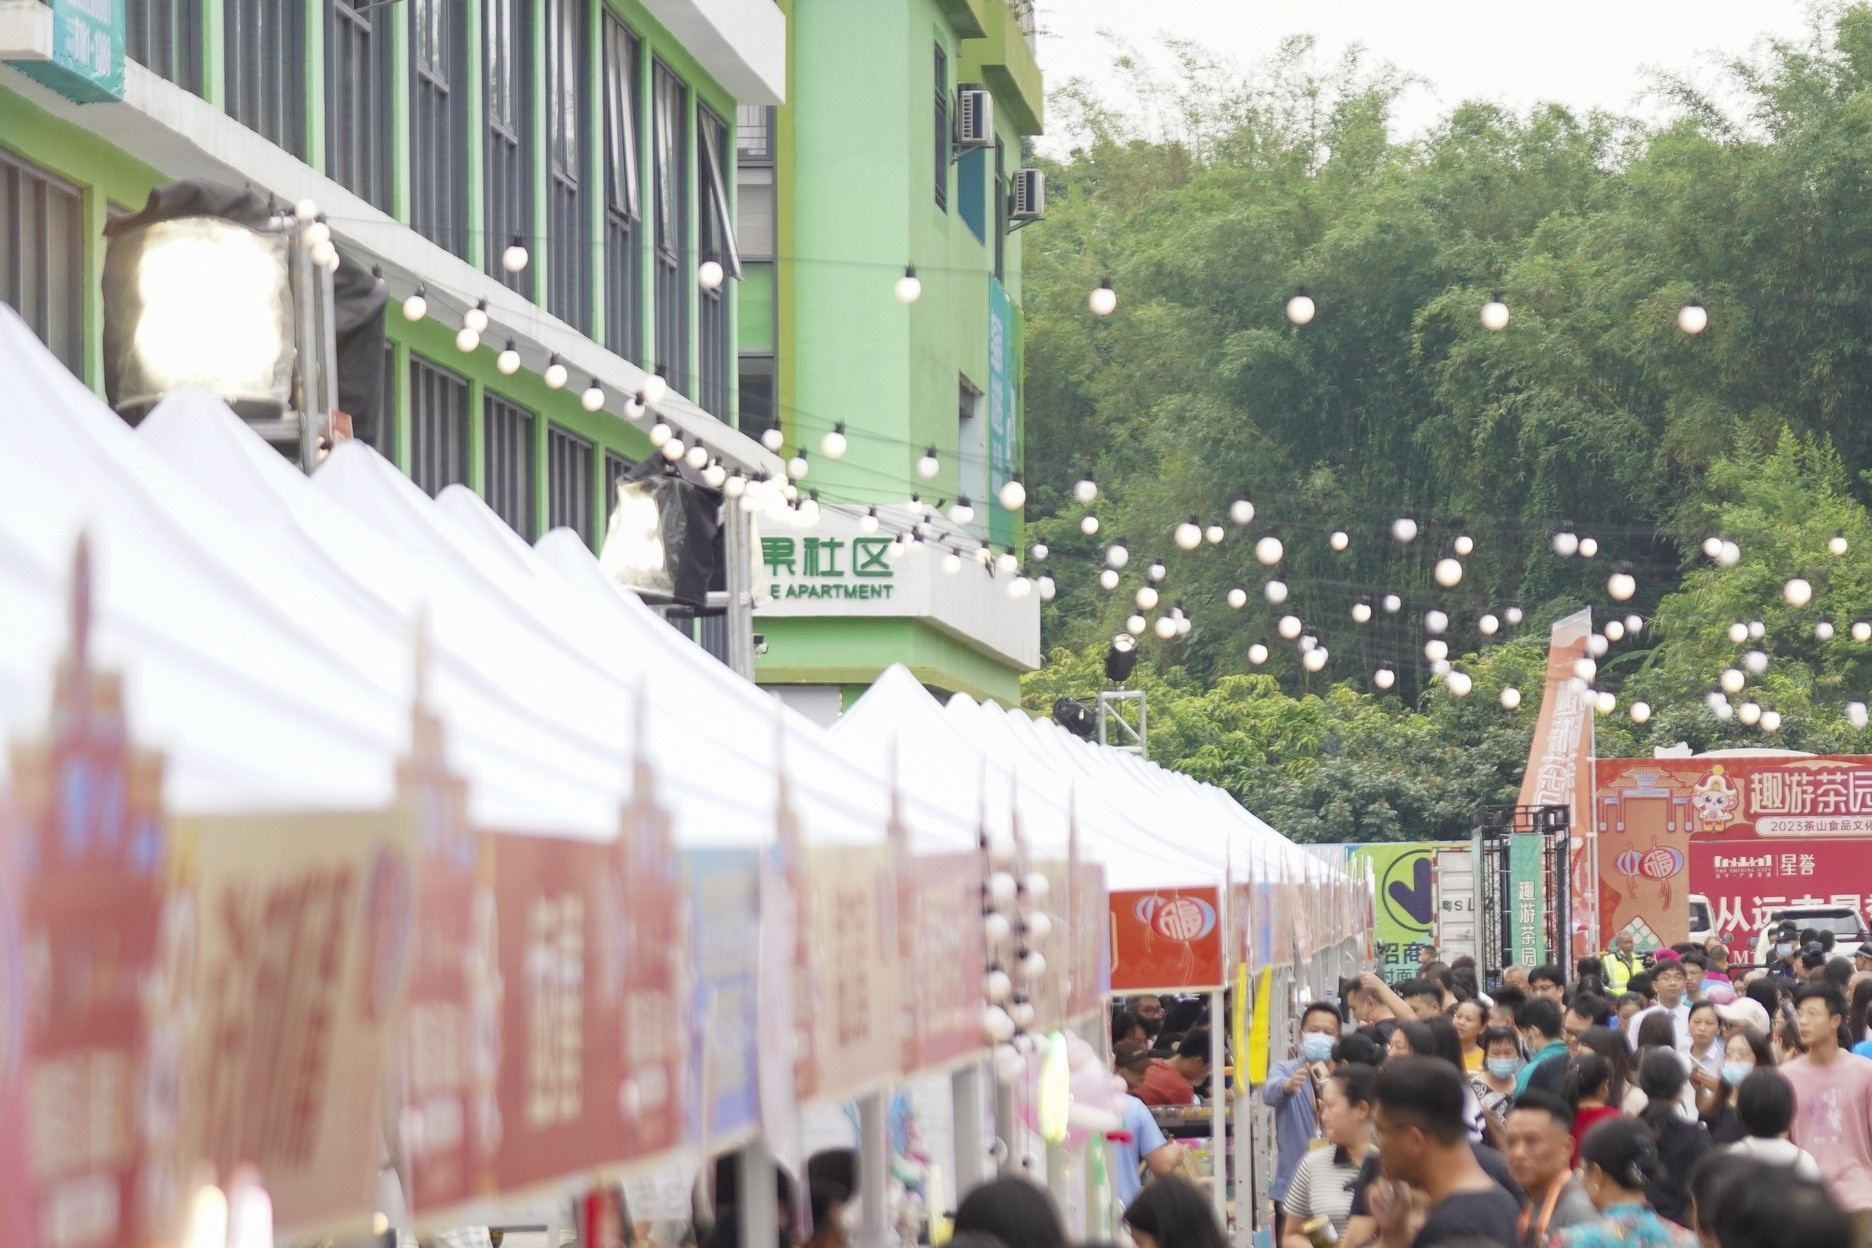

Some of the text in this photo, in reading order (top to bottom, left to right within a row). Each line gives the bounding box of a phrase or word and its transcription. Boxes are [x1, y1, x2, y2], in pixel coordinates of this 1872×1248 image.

[786, 584, 894, 599] APARTMENT
[1781, 853, 1815, 876] 星誉
[1519, 881, 1536, 967] 趣游茶园
